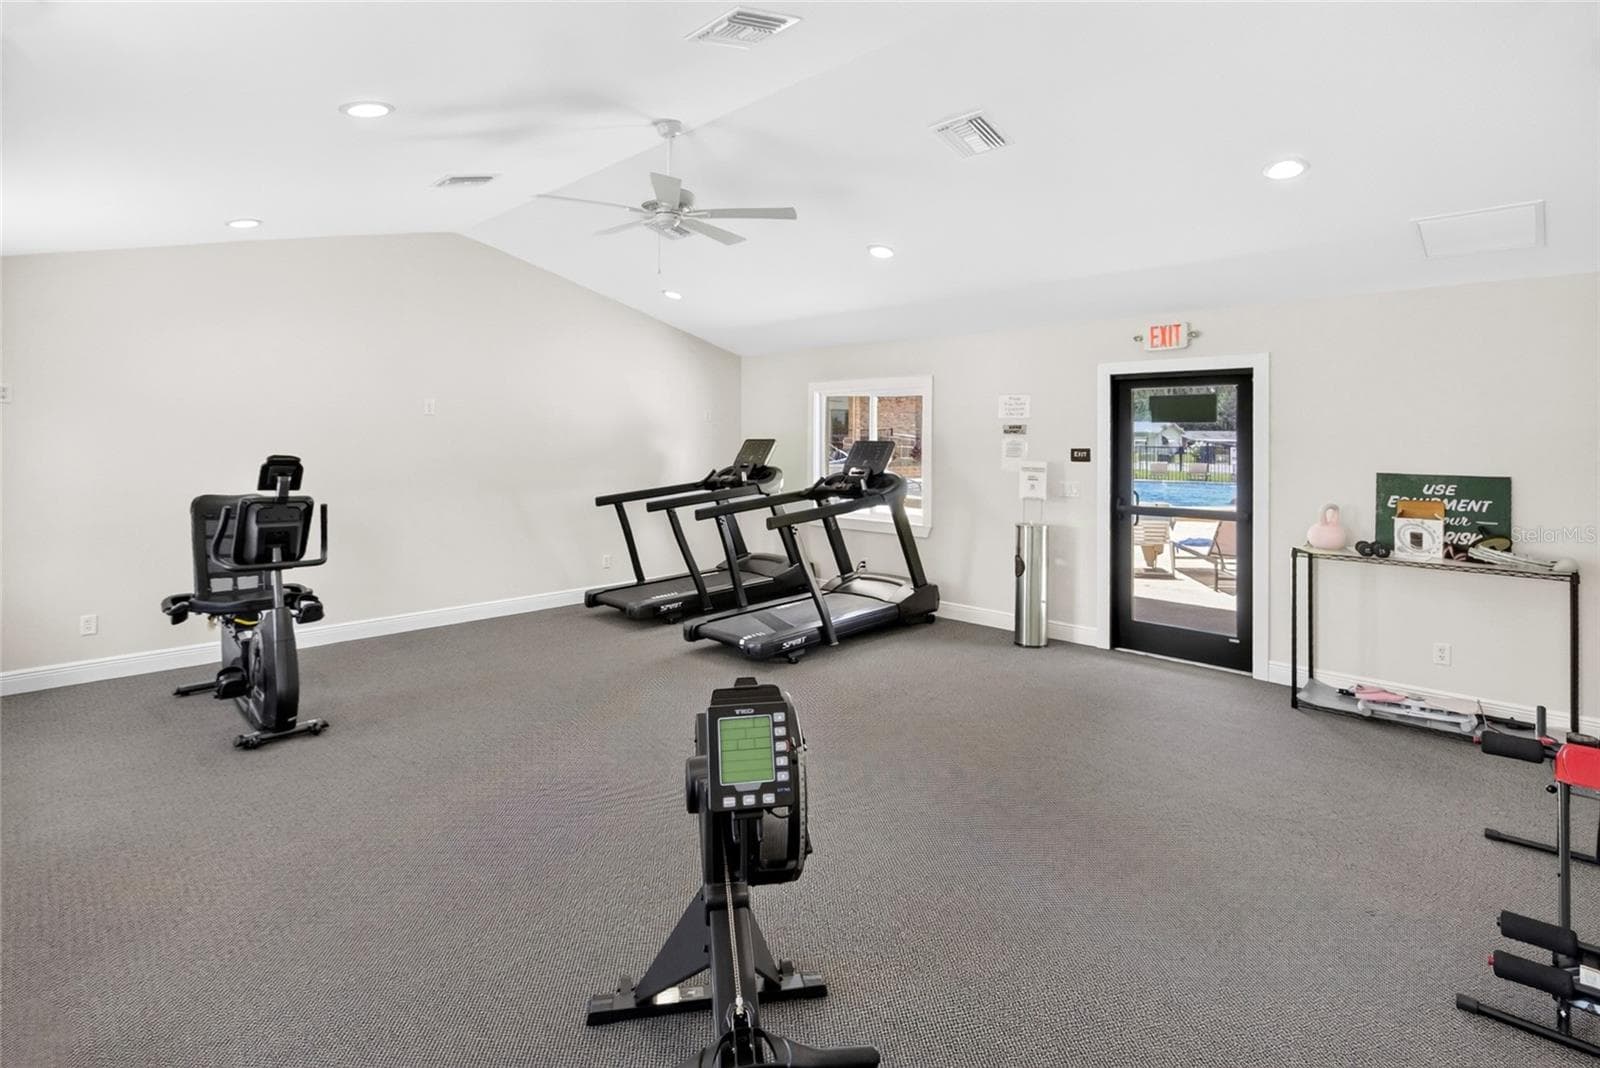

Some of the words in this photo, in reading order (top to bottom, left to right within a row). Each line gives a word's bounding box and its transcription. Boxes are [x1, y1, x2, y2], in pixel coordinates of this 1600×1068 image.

[1150, 324, 1181, 348] EXIT
[1422, 484, 1457, 496] USE
[1387, 495, 1493, 513] EMENT
[1444, 516, 1472, 527] our
